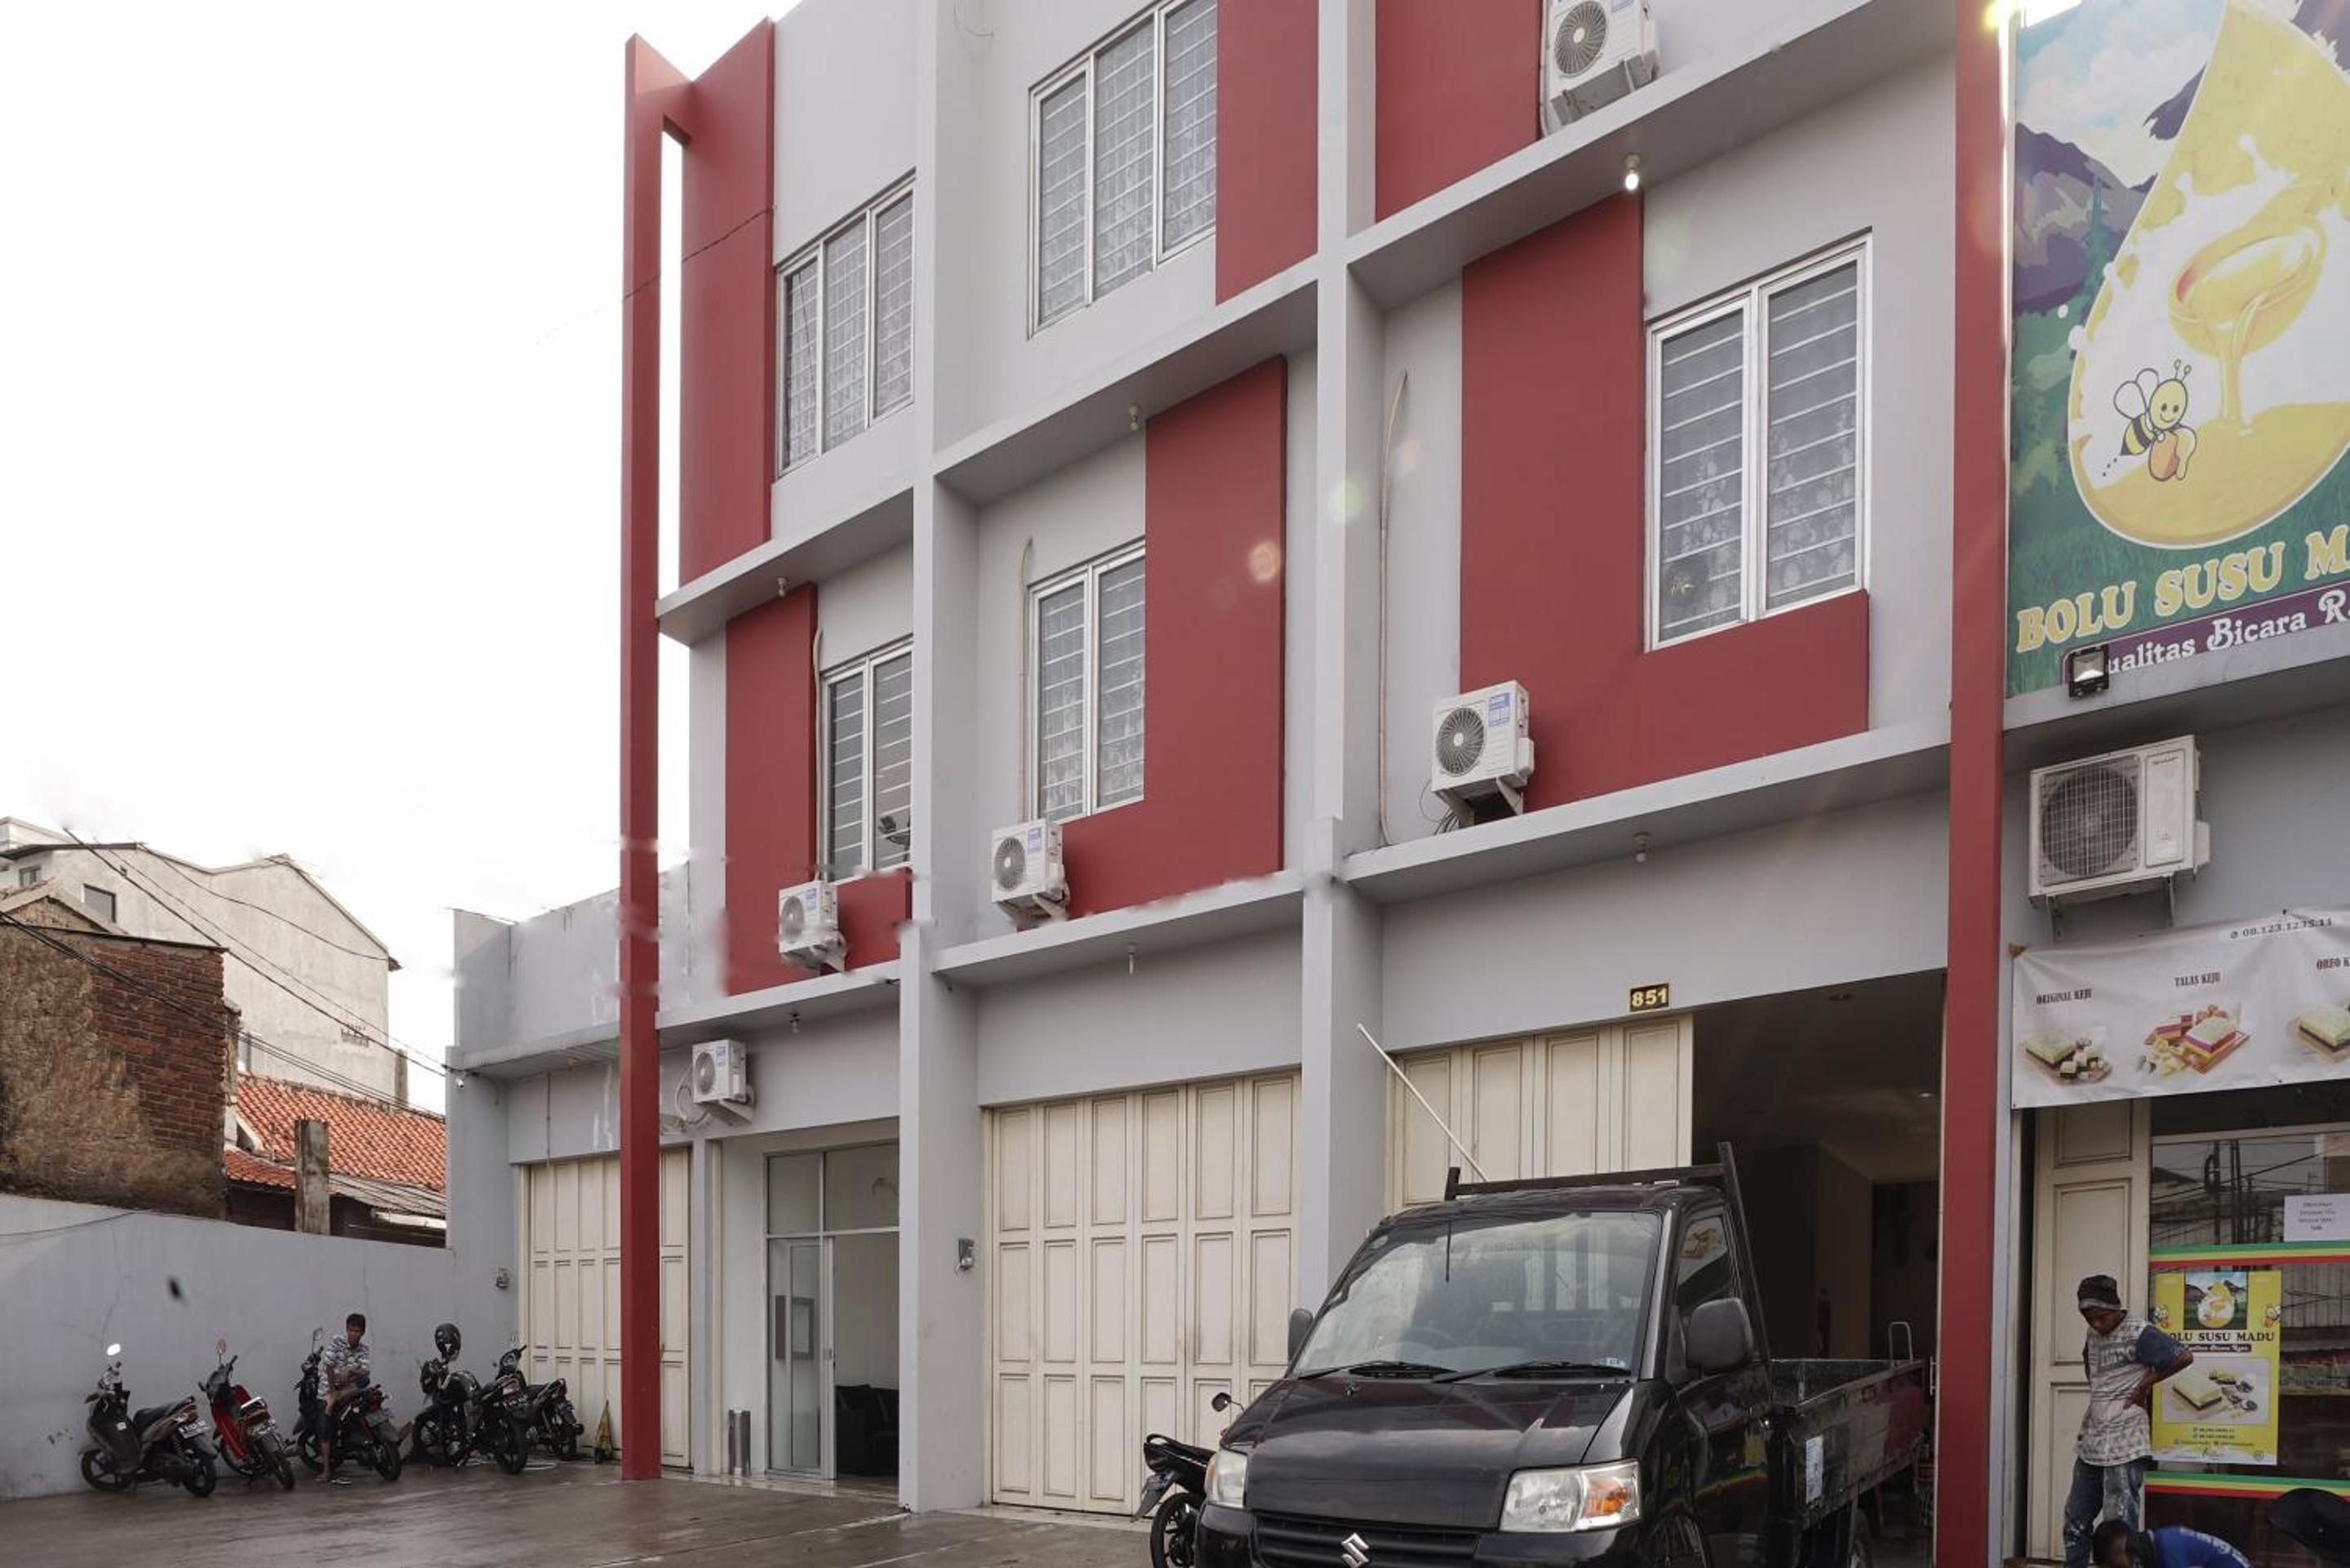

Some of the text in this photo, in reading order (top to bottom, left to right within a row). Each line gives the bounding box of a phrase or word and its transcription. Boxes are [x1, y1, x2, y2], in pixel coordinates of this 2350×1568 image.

[2016, 524, 2350, 653] BOLU SUSU M
[2108, 589, 2350, 674] ualitas Bicara R
[1632, 988, 1667, 1006] 851
[2170, 1332, 2274, 1341] OLU SUSU MADU
